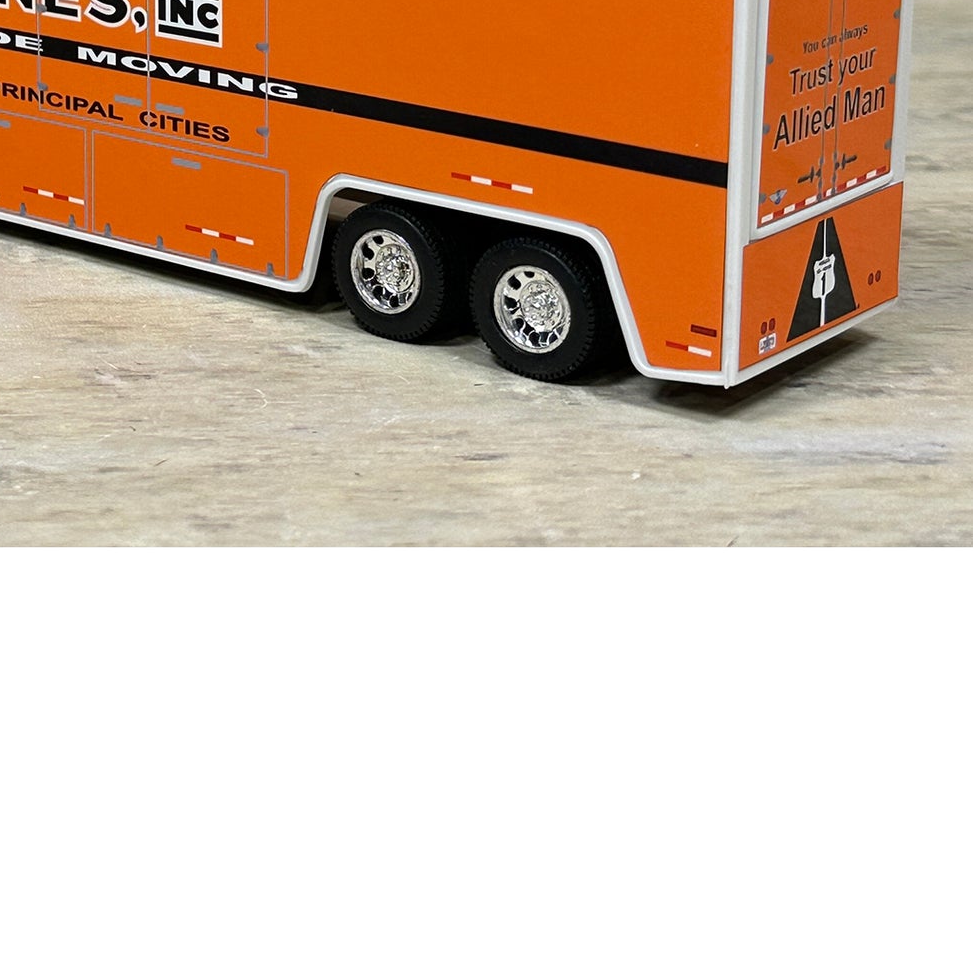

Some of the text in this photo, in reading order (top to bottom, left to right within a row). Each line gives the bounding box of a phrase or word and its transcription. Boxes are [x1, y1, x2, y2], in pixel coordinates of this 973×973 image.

[803, 40, 819, 54] You
[77, 46, 298, 100] MOVING
[790, 48, 876, 95] Trust your
[139, 111, 231, 143] CITIES
[773, 86, 885, 150] Allied Man
